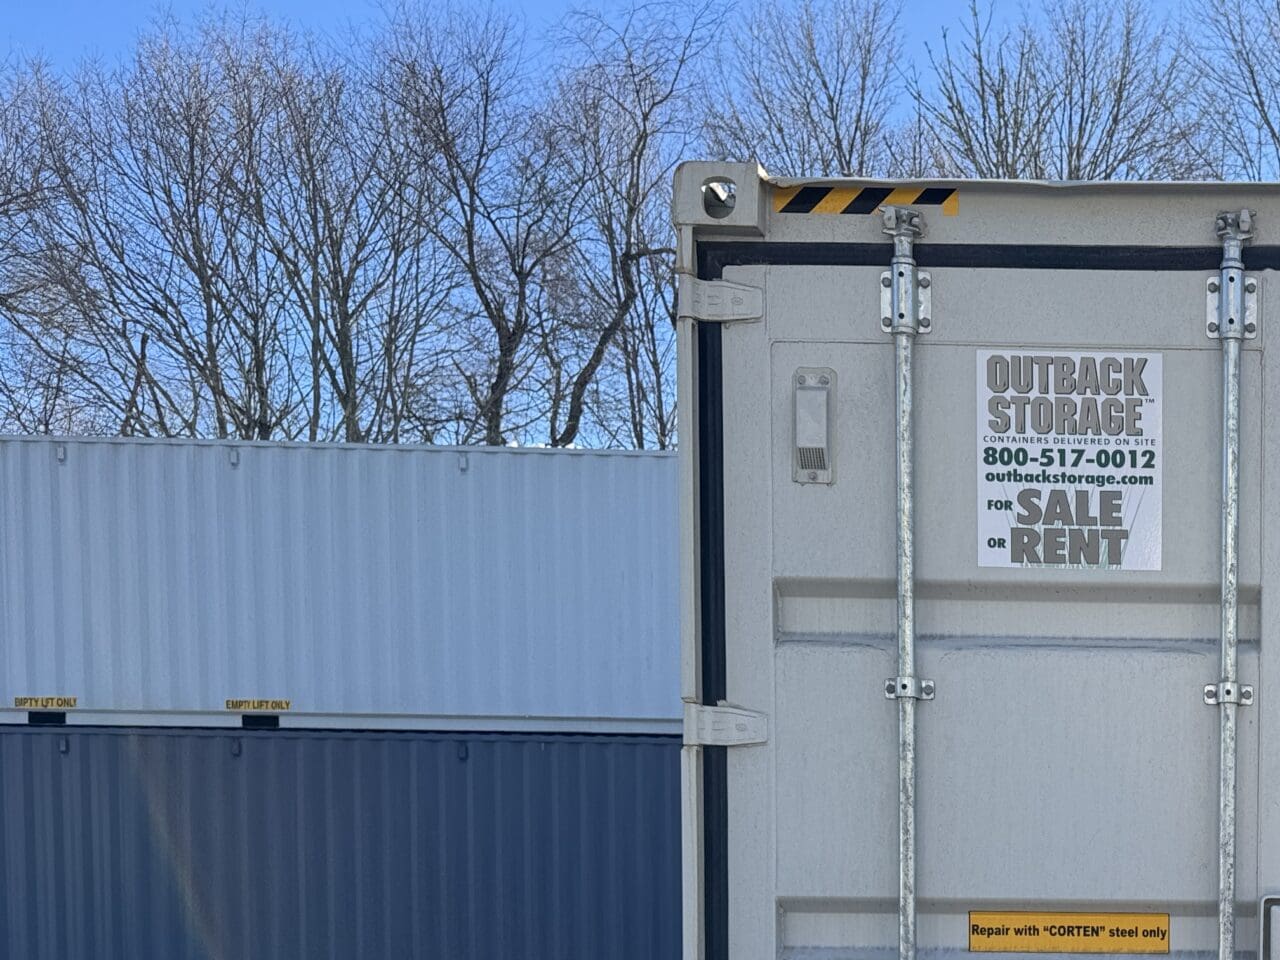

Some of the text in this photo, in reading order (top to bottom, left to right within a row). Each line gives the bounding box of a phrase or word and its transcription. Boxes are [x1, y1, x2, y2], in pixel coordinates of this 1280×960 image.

[986, 354, 1149, 397] OUTBACK
[987, 395, 1144, 437] STORAGE
[983, 435, 1156, 447] CONTAINERS DELIVERED ON SITE
[983, 446, 1156, 469] 800-517-0012
[985, 468, 1154, 487] outbackstorage.com
[987, 488, 1123, 527] FOR SALE
[987, 527, 1129, 565] OR RENT
[971, 924, 1011, 938] Repair
[1013, 924, 1040, 937] with
[1109, 926, 1138, 938] steel
[1142, 926, 1168, 940] only
